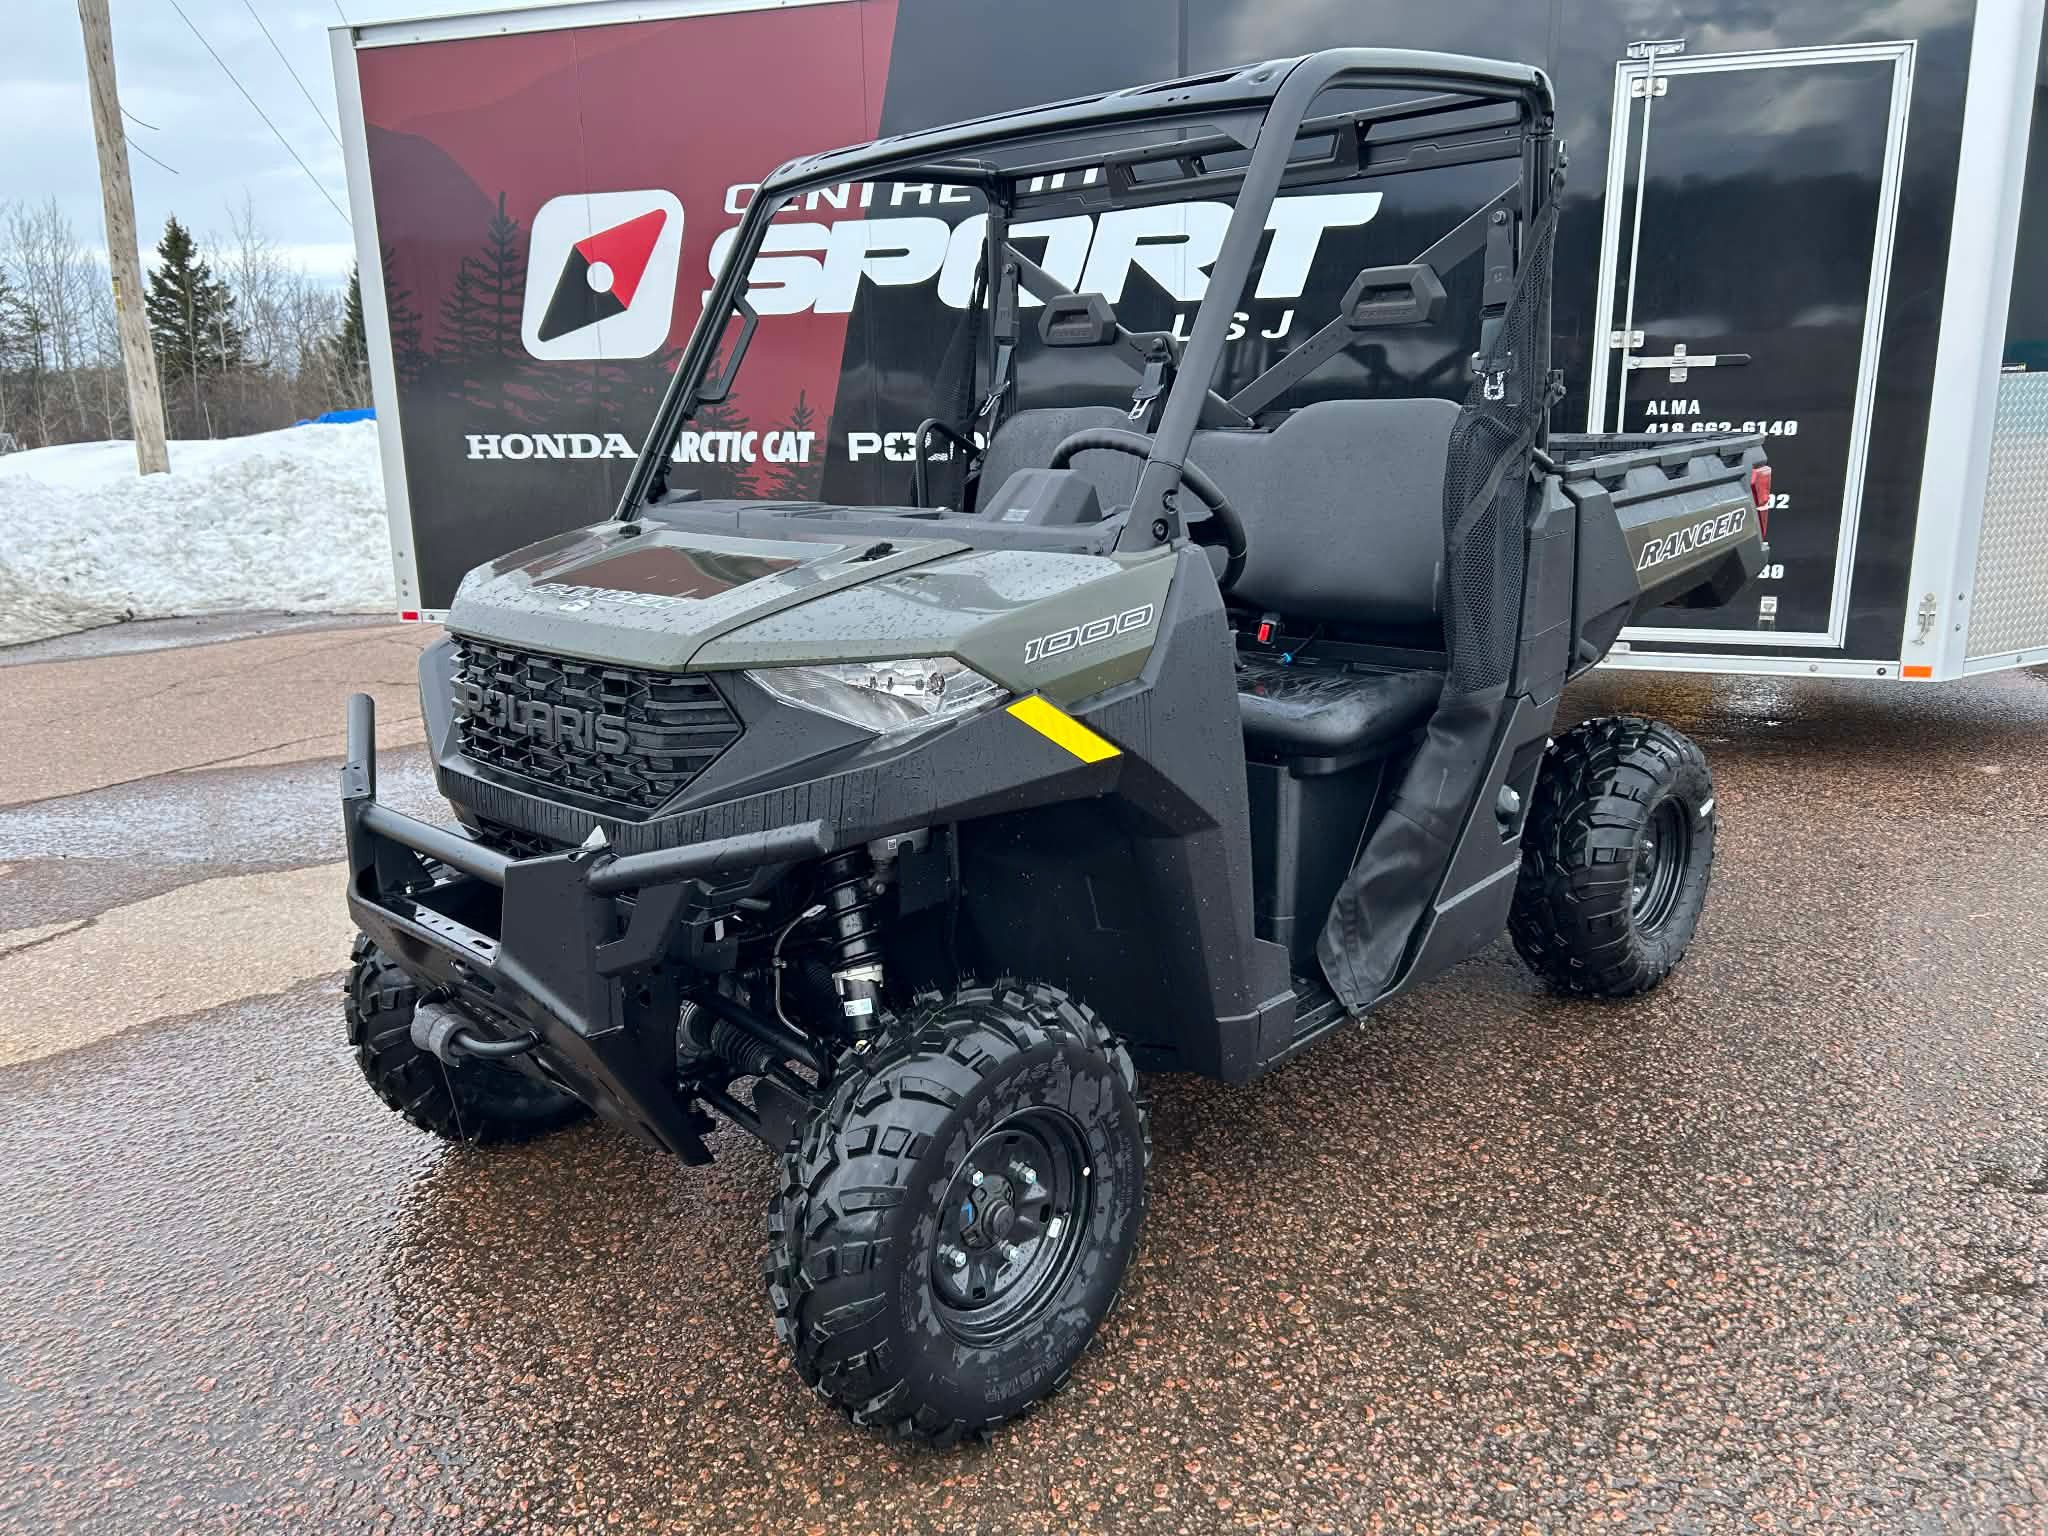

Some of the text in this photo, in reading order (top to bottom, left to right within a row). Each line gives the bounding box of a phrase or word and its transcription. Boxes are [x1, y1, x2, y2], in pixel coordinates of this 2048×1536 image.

[1645, 400, 1701, 416] ALMA
[465, 433, 638, 460] HONDA
[762, 431, 815, 463] CAT
[1636, 507, 1746, 571] RANGER
[1024, 603, 1153, 664] 1000
[464, 681, 630, 755] POLARIS
